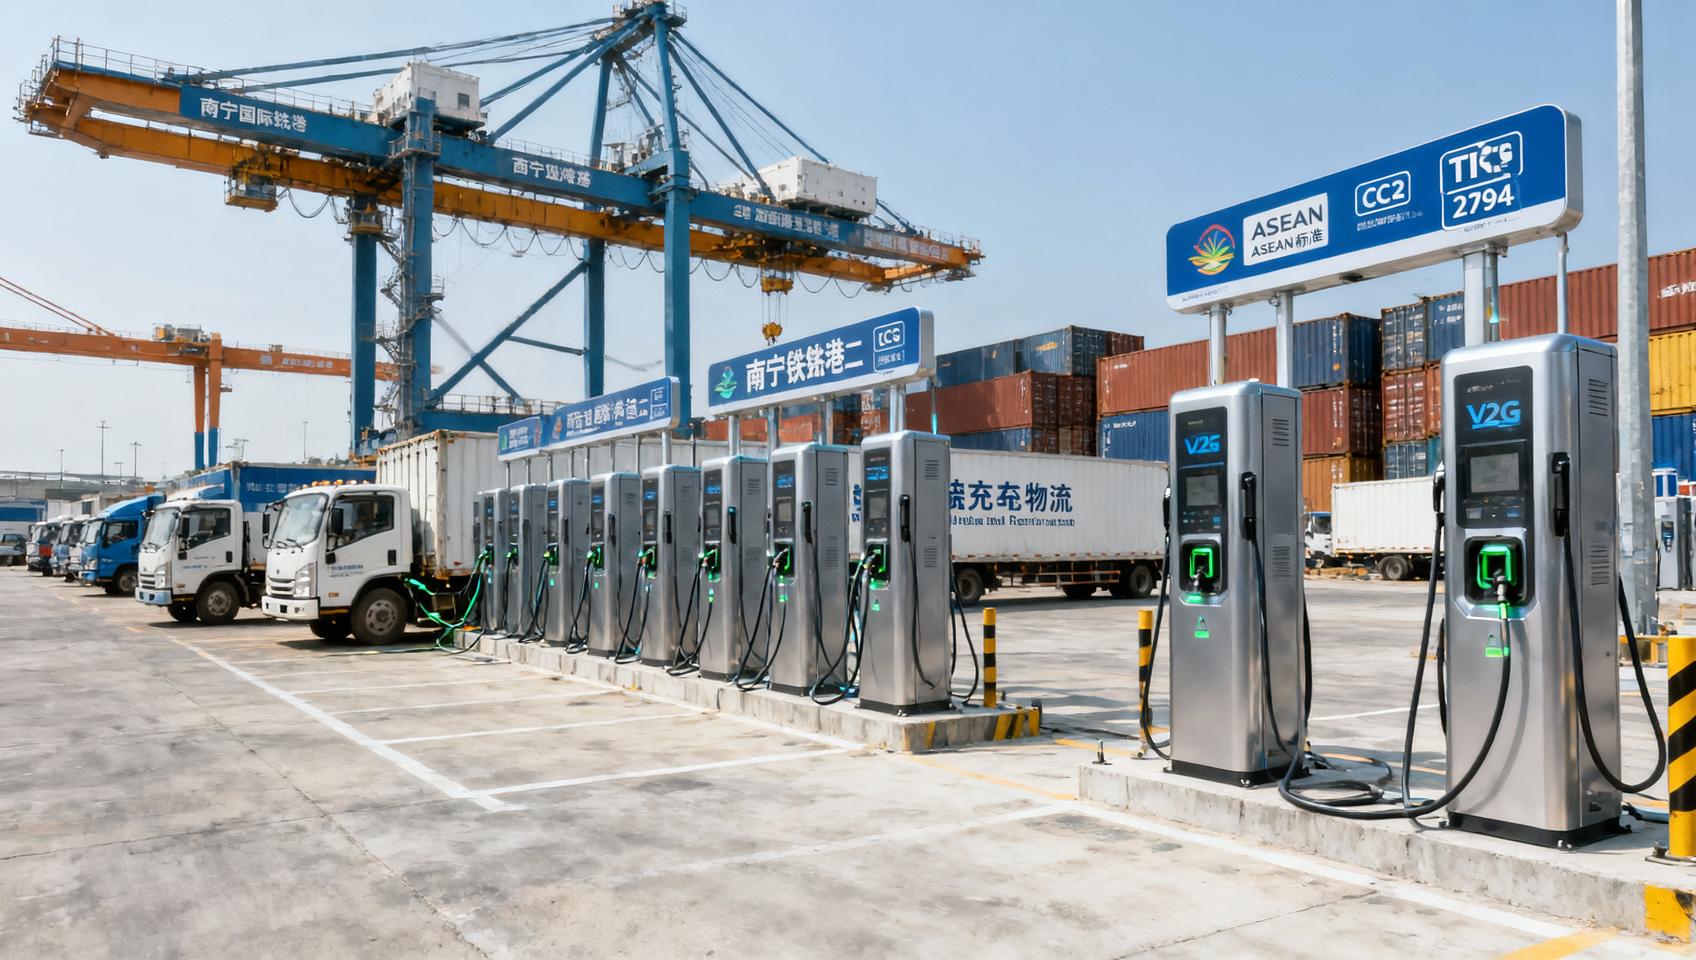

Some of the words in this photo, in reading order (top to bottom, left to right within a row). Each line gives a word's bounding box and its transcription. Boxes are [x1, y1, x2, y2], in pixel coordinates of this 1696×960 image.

[1362, 179, 1405, 208] CC2
[1453, 184, 1515, 219] 2794
[1251, 204, 1323, 241] ASEAN
[1251, 237, 1293, 257] ASEAN
[1466, 400, 1521, 428] V2G
